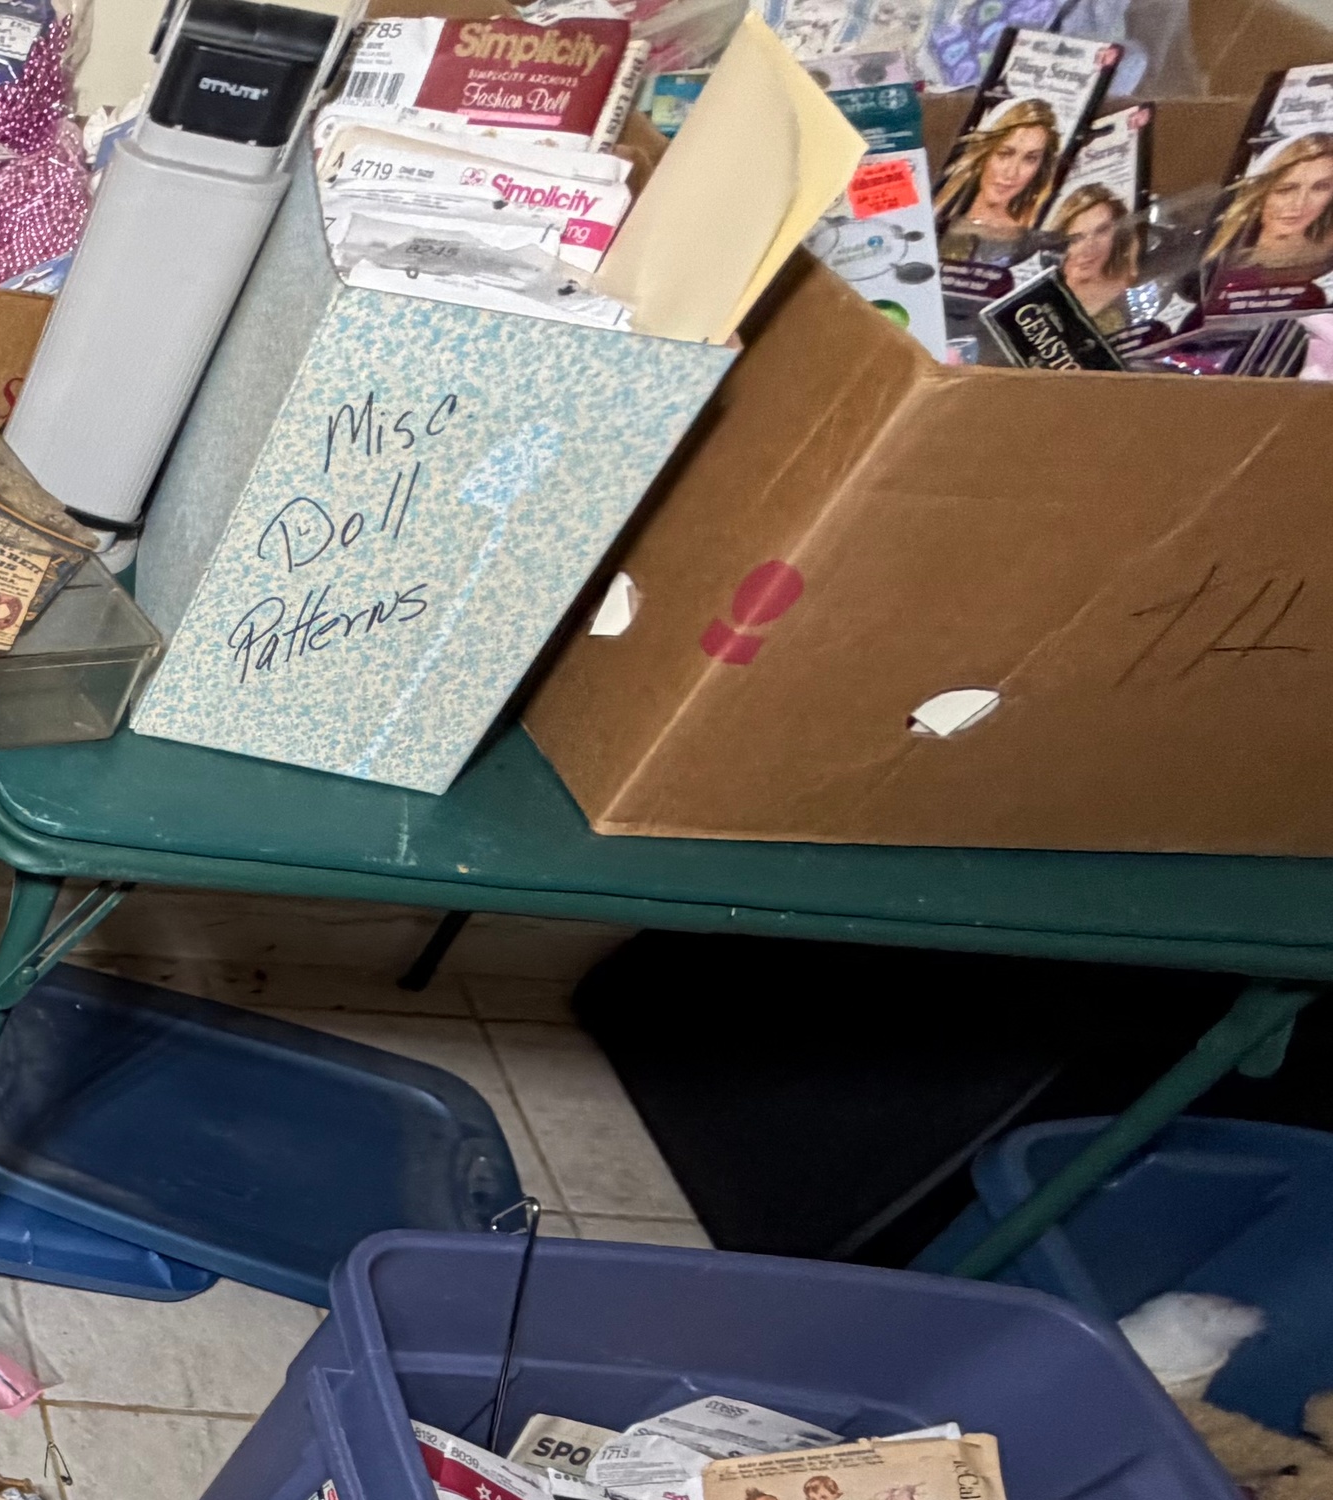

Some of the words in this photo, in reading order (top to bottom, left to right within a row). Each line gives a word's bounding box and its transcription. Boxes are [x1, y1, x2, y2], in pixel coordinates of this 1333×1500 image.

[454, 22, 610, 77] Simplicity
[462, 82, 524, 110] Fashion
[527, 87, 572, 114] Doll
[350, 159, 394, 180] 4719
[491, 173, 602, 216] Simplicity
[324, 391, 459, 473] Misc
[256, 462, 421, 572] Doll
[226, 582, 429, 684] Patterns
[450, 1446, 480, 1471] 8039
